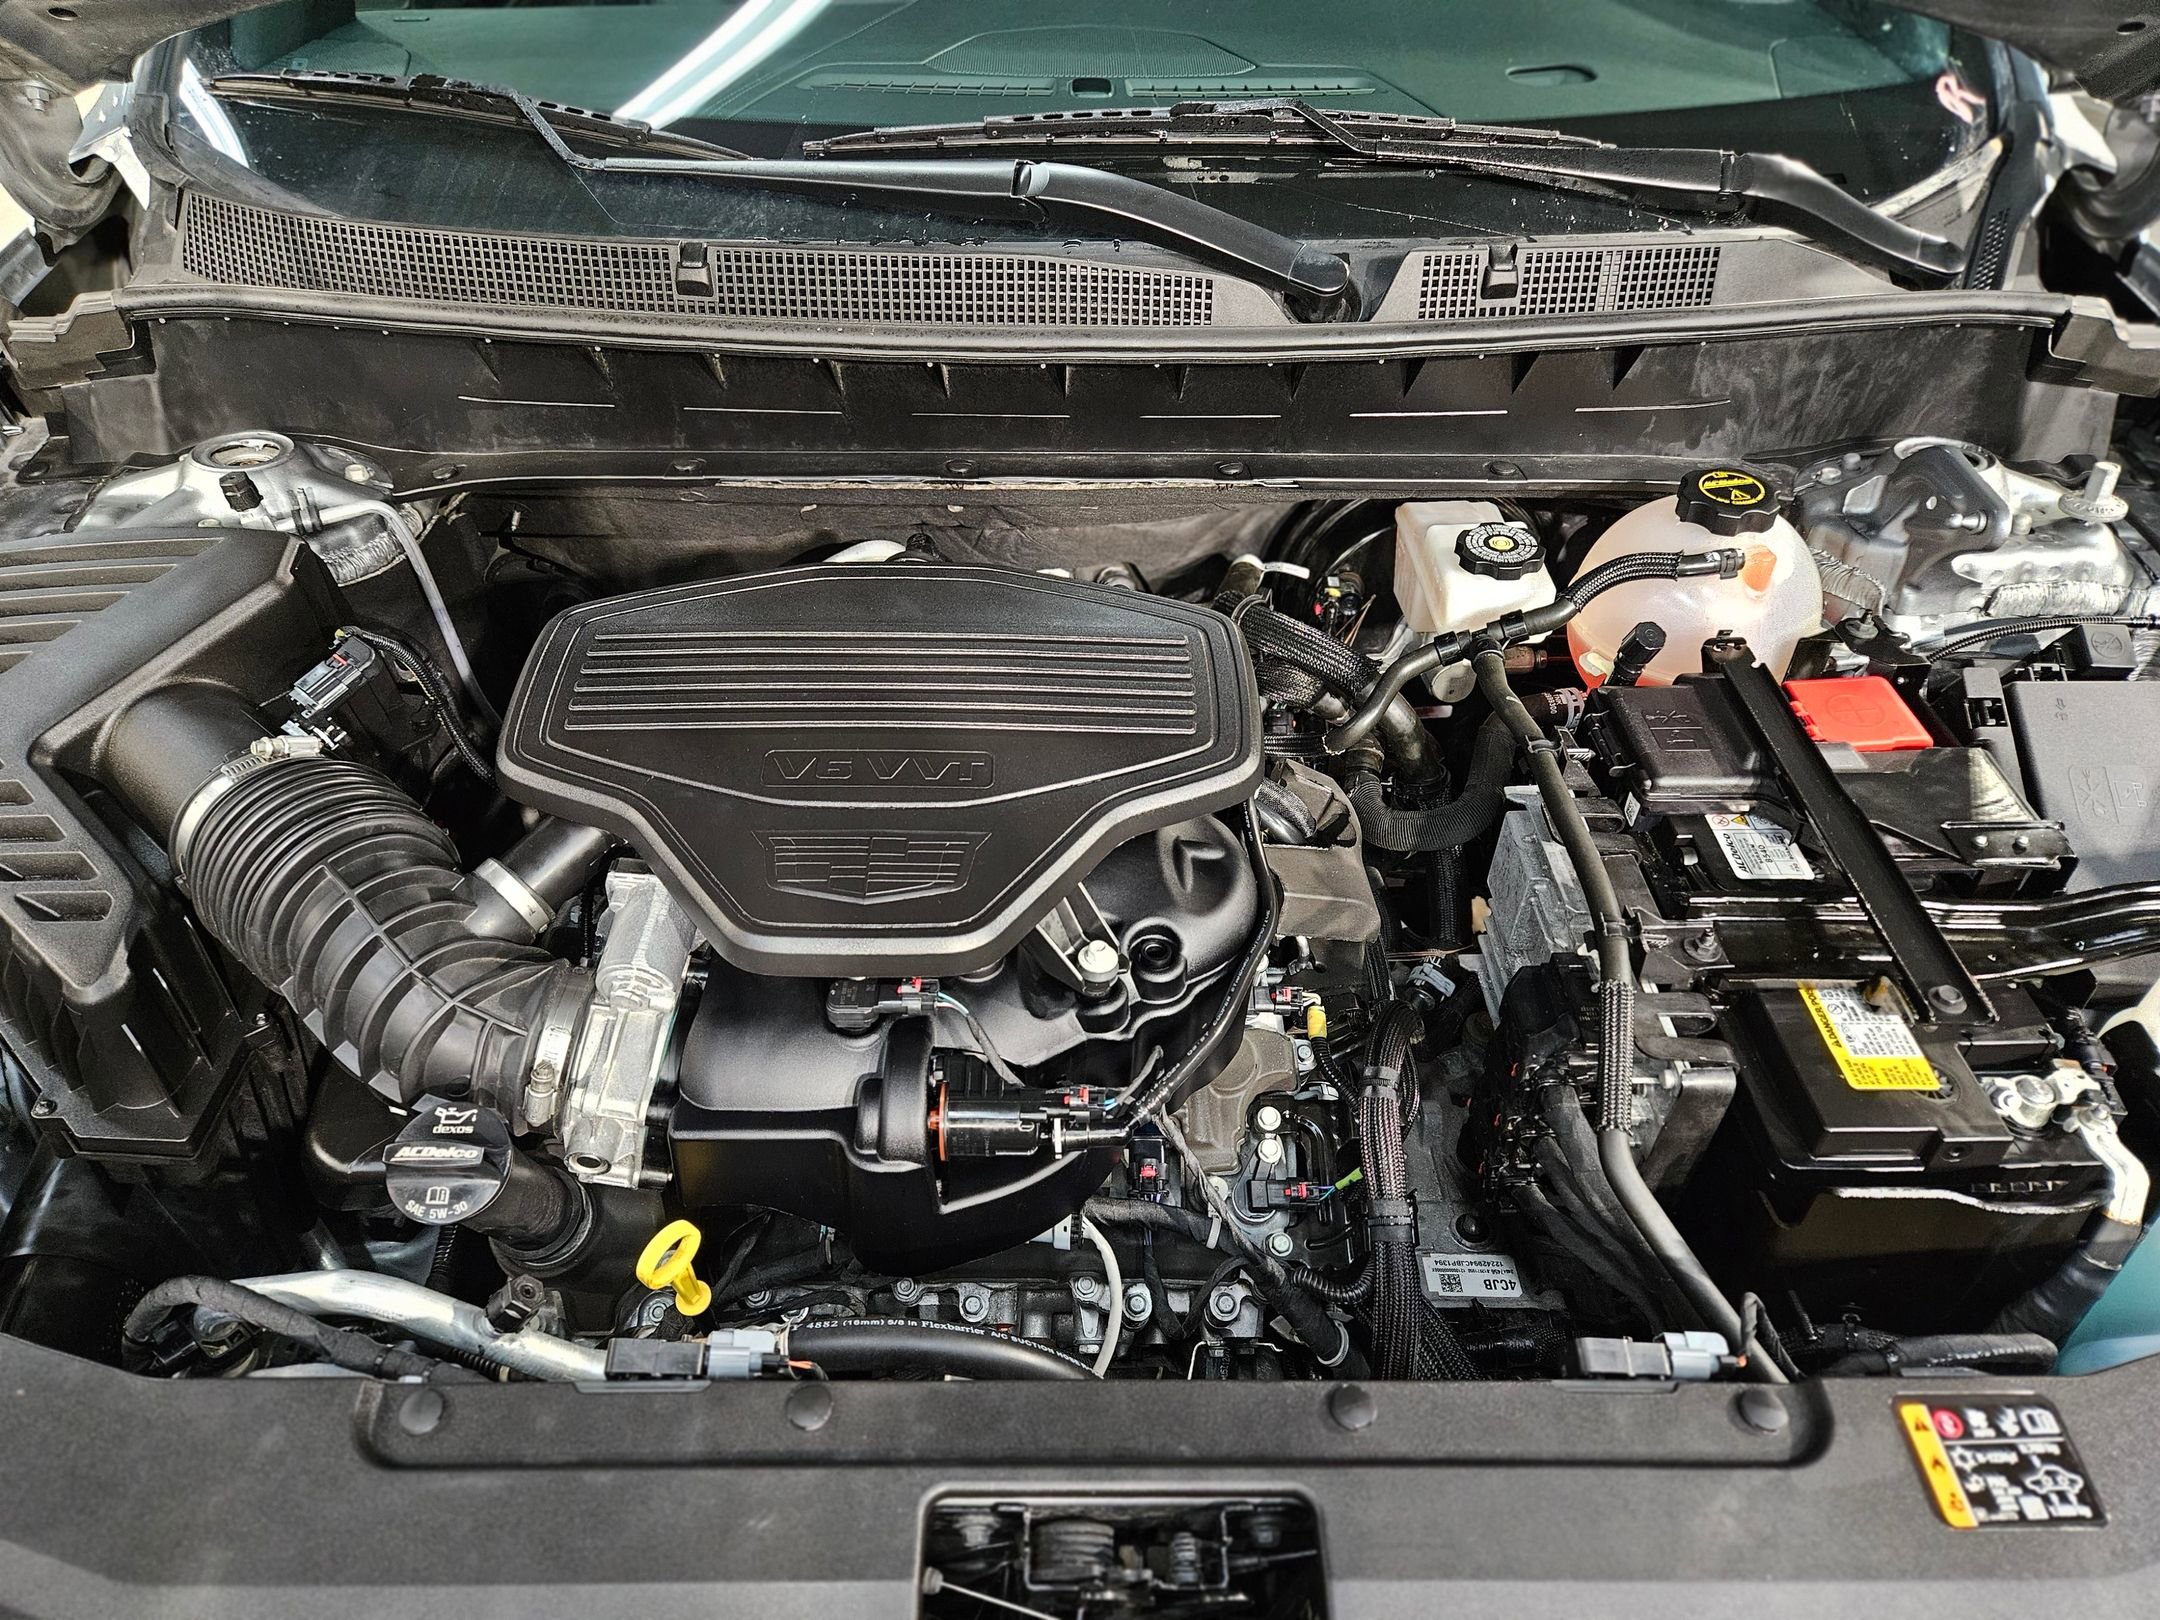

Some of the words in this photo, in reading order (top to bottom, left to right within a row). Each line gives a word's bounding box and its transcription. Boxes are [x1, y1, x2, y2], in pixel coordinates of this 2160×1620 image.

[772, 757, 852, 780] V6
[867, 757, 985, 781] VVT
[1723, 833, 1749, 874] ACDelco
[1815, 1006, 1838, 1040] DANGER
[432, 1124, 475, 1135] dexos
[394, 1146, 479, 1159] ACDelco
[405, 1200, 426, 1217] SAE
[429, 1201, 468, 1219] 5W-30
[1483, 1279, 1517, 1291] 4CJB
[806, 1320, 839, 1329] 4882
[842, 1319, 885, 1327] (16mm)
[920, 1320, 986, 1336] Flexbarrier
[990, 1331, 1009, 1340] A/C
[1011, 1336, 1055, 1354] SUCTION
